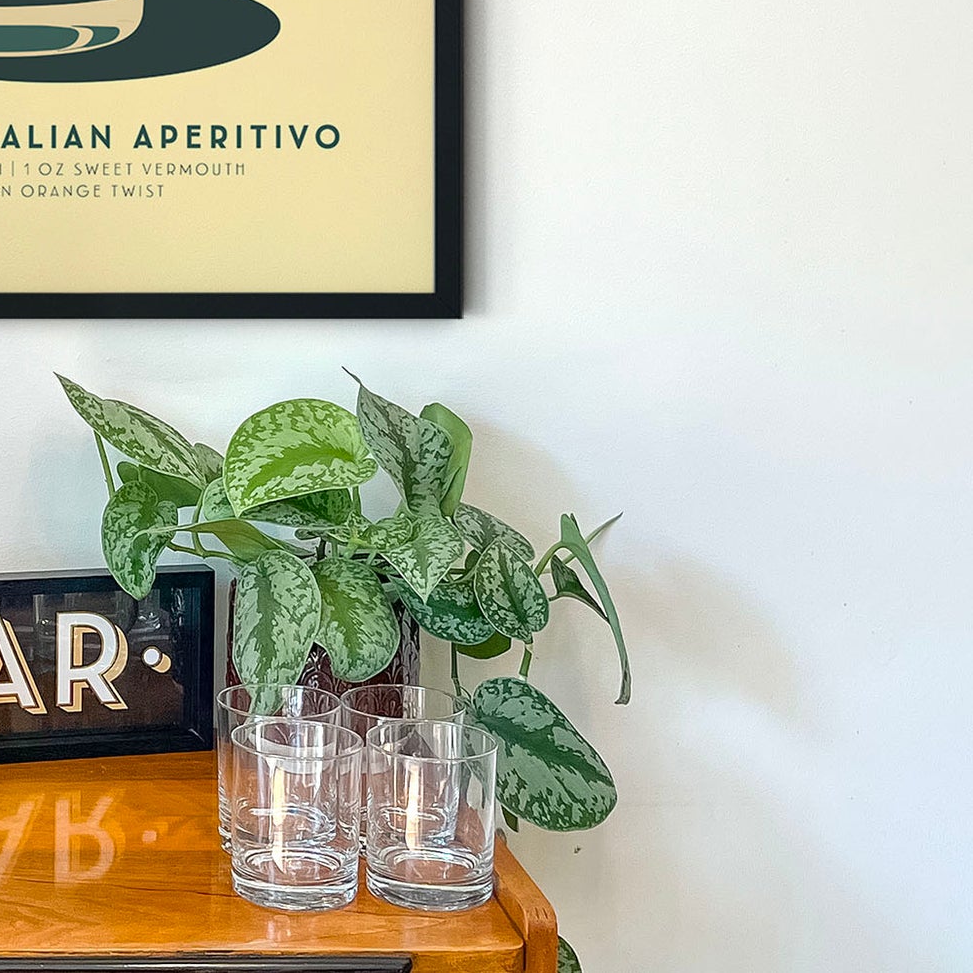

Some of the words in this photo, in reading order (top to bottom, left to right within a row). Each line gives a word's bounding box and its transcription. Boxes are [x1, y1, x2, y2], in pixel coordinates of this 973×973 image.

[132, 123, 341, 150] APERITIVO
[23, 162, 30, 176] 1
[38, 162, 64, 177] OZ
[73, 162, 133, 177] SWEET
[141, 162, 245, 177] VERMOUTH
[20, 184, 101, 199] ORANGE
[111, 184, 164, 199] TWIST
